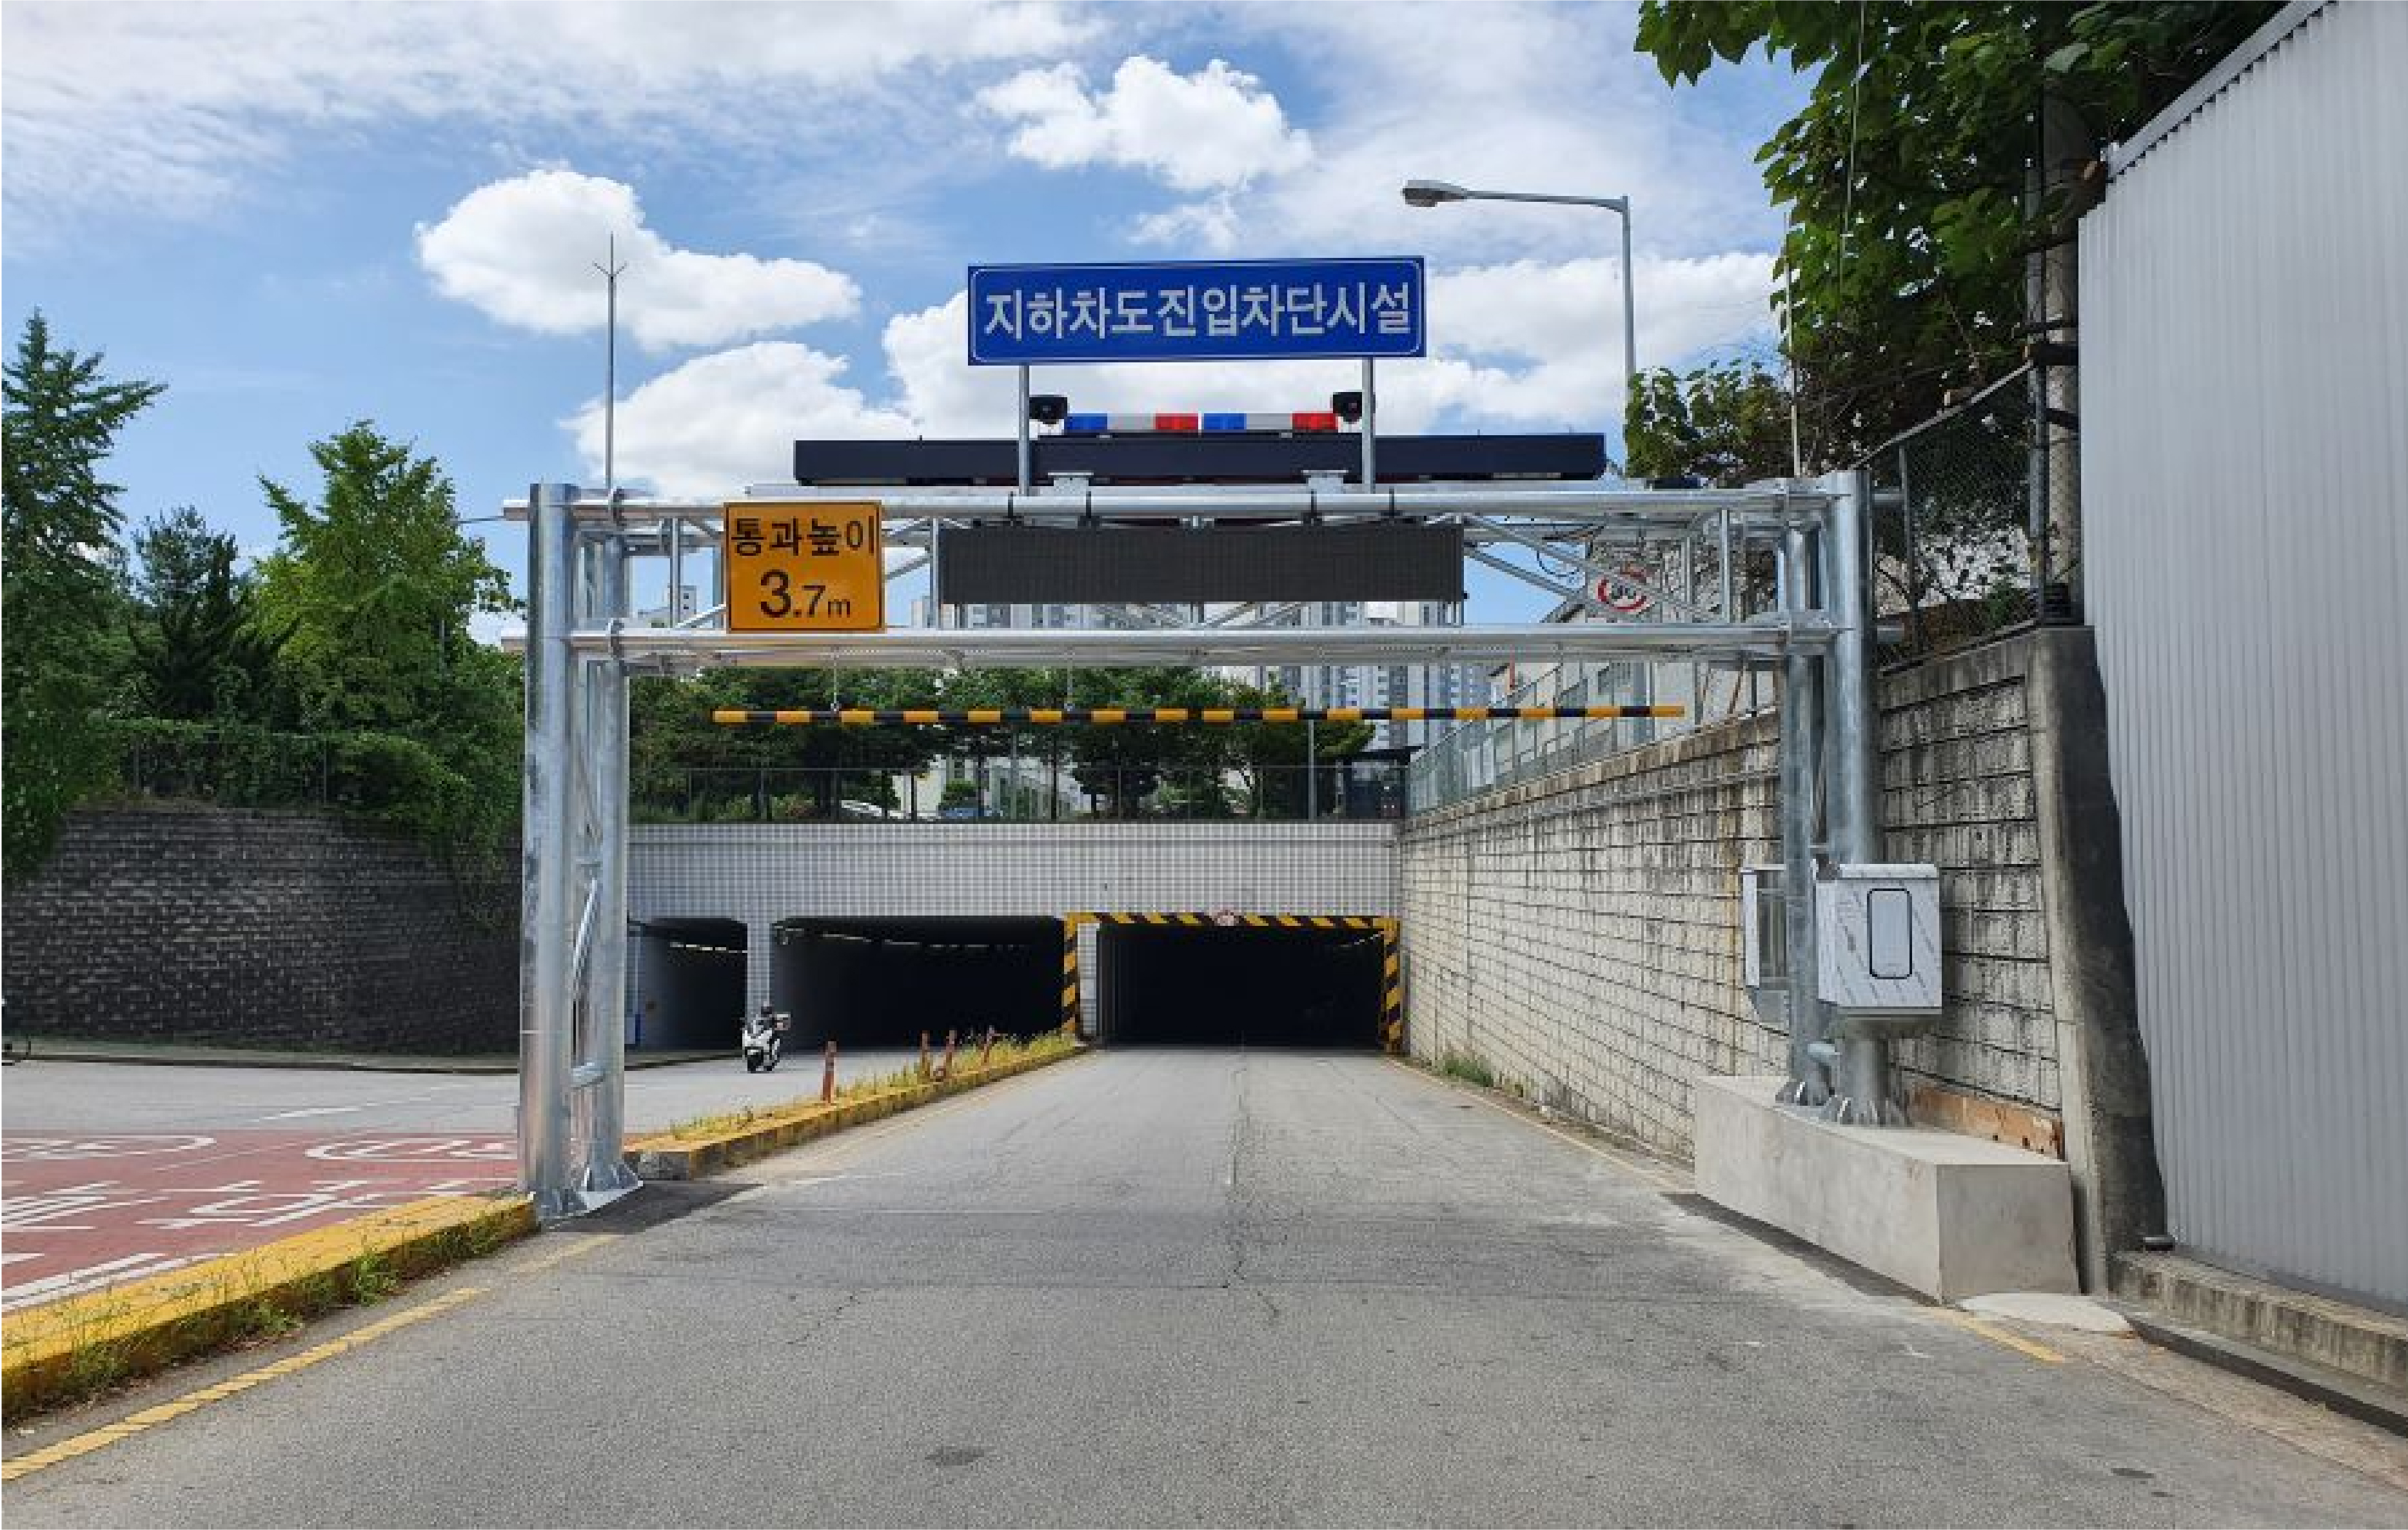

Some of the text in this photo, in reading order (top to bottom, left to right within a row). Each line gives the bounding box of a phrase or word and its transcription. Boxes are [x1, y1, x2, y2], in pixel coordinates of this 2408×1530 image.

[984, 282, 1411, 341] 지하차도진입차단시설
[731, 516, 874, 556] 통과높이
[760, 569, 851, 618] 3.7m
